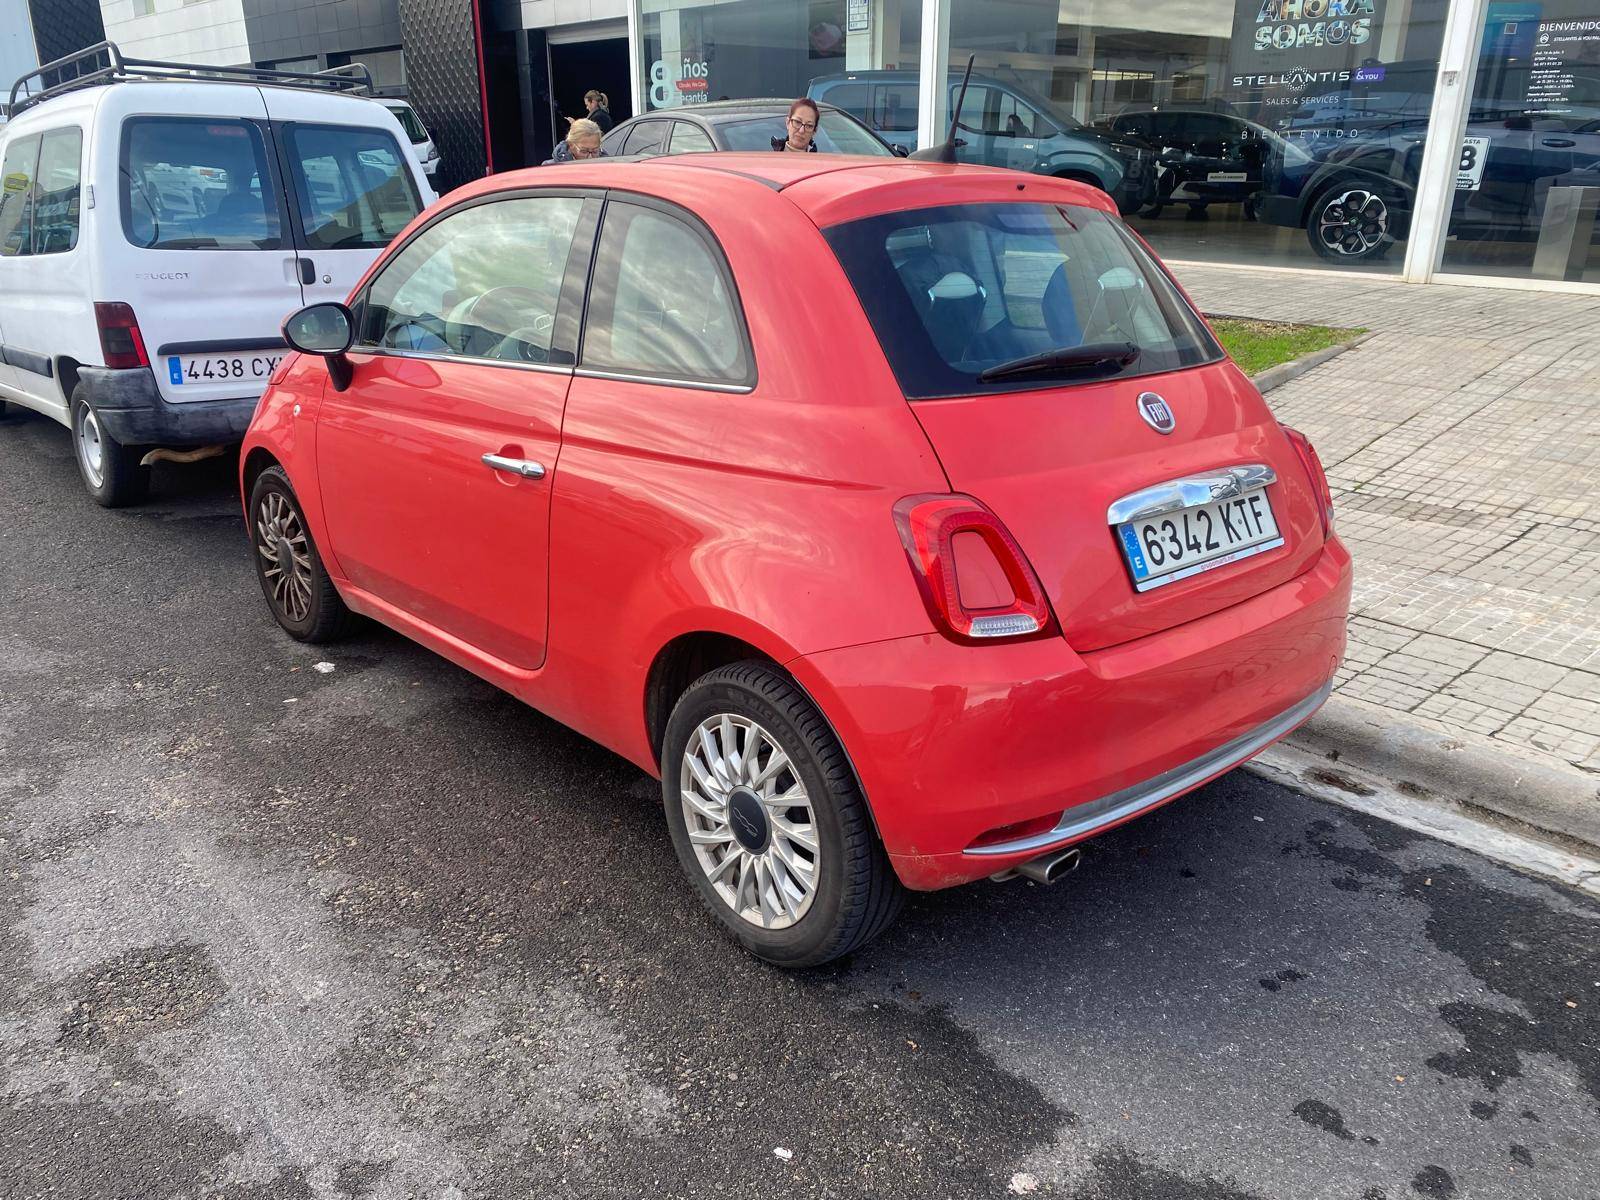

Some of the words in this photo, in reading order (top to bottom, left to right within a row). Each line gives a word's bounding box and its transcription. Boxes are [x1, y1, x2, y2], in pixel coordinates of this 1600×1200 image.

[1256, 0, 1375, 23] AHORA
[1254, 18, 1371, 51] SOMOS
[650, 60, 675, 109] 8
[1232, 71, 1350, 87] STELLANTIS
[1266, 97, 1290, 106] SALES
[1292, 97, 1298, 105] &
[1301, 95, 1340, 105] SERVICES
[188, 358, 244, 380] 4438
[251, 357, 284, 378] CX
[1146, 403, 1170, 422] FIAT
[1142, 509, 1220, 566] 6342
[1217, 495, 1264, 544] KTF
[1134, 556, 1144, 569] E
